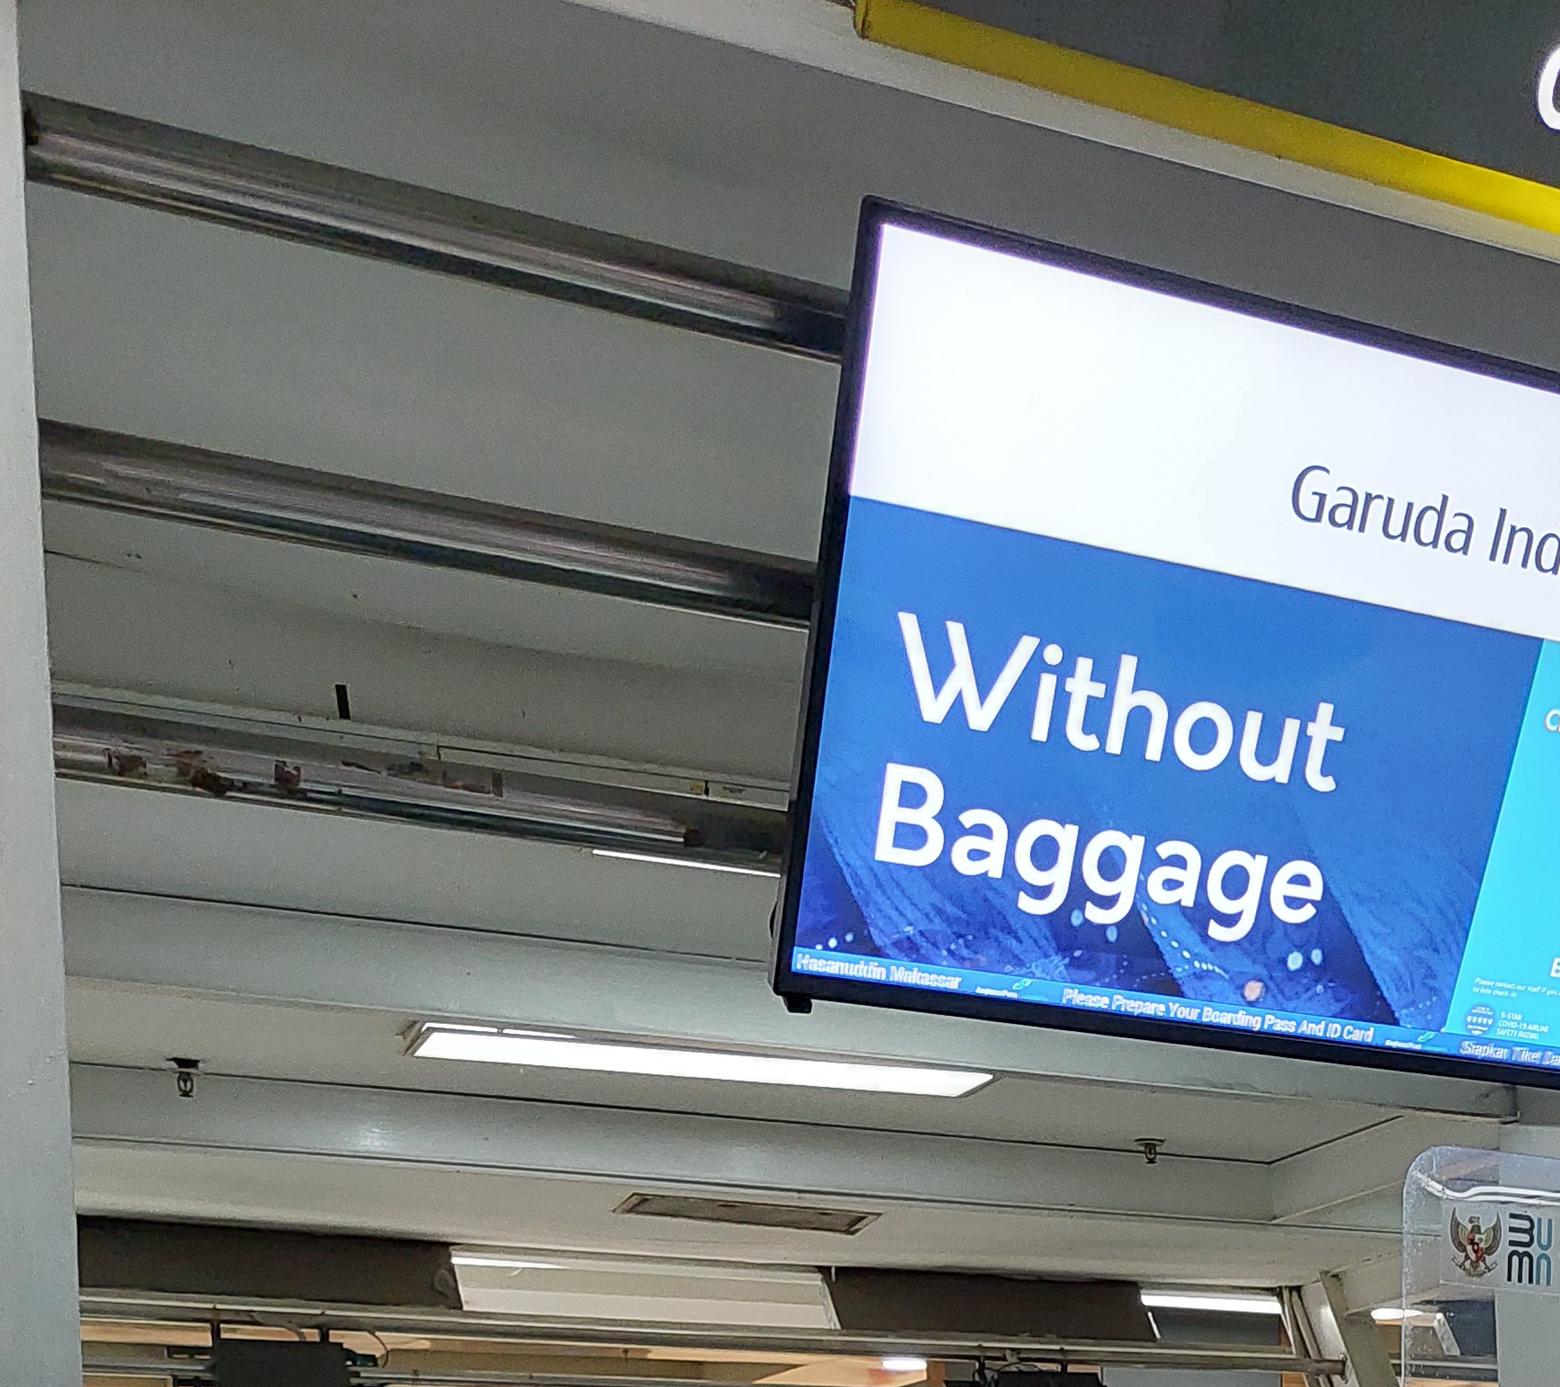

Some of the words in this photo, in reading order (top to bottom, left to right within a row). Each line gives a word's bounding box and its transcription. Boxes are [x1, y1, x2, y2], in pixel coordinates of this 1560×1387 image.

[1291, 464, 1475, 556] Garuda
[897, 611, 1346, 793] Without
[873, 762, 1324, 943] Baggage
[1061, 987, 1109, 1010] Please
[1111, 994, 1167, 1019] Prepare
[1168, 1002, 1200, 1022] Your
[1201, 1006, 1261, 1032] Boarding
[1263, 1013, 1297, 1034] Pass
[1298, 1017, 1324, 1038] And
[1325, 1020, 1341, 1039] ID
[1341, 1021, 1375, 1043] Card
